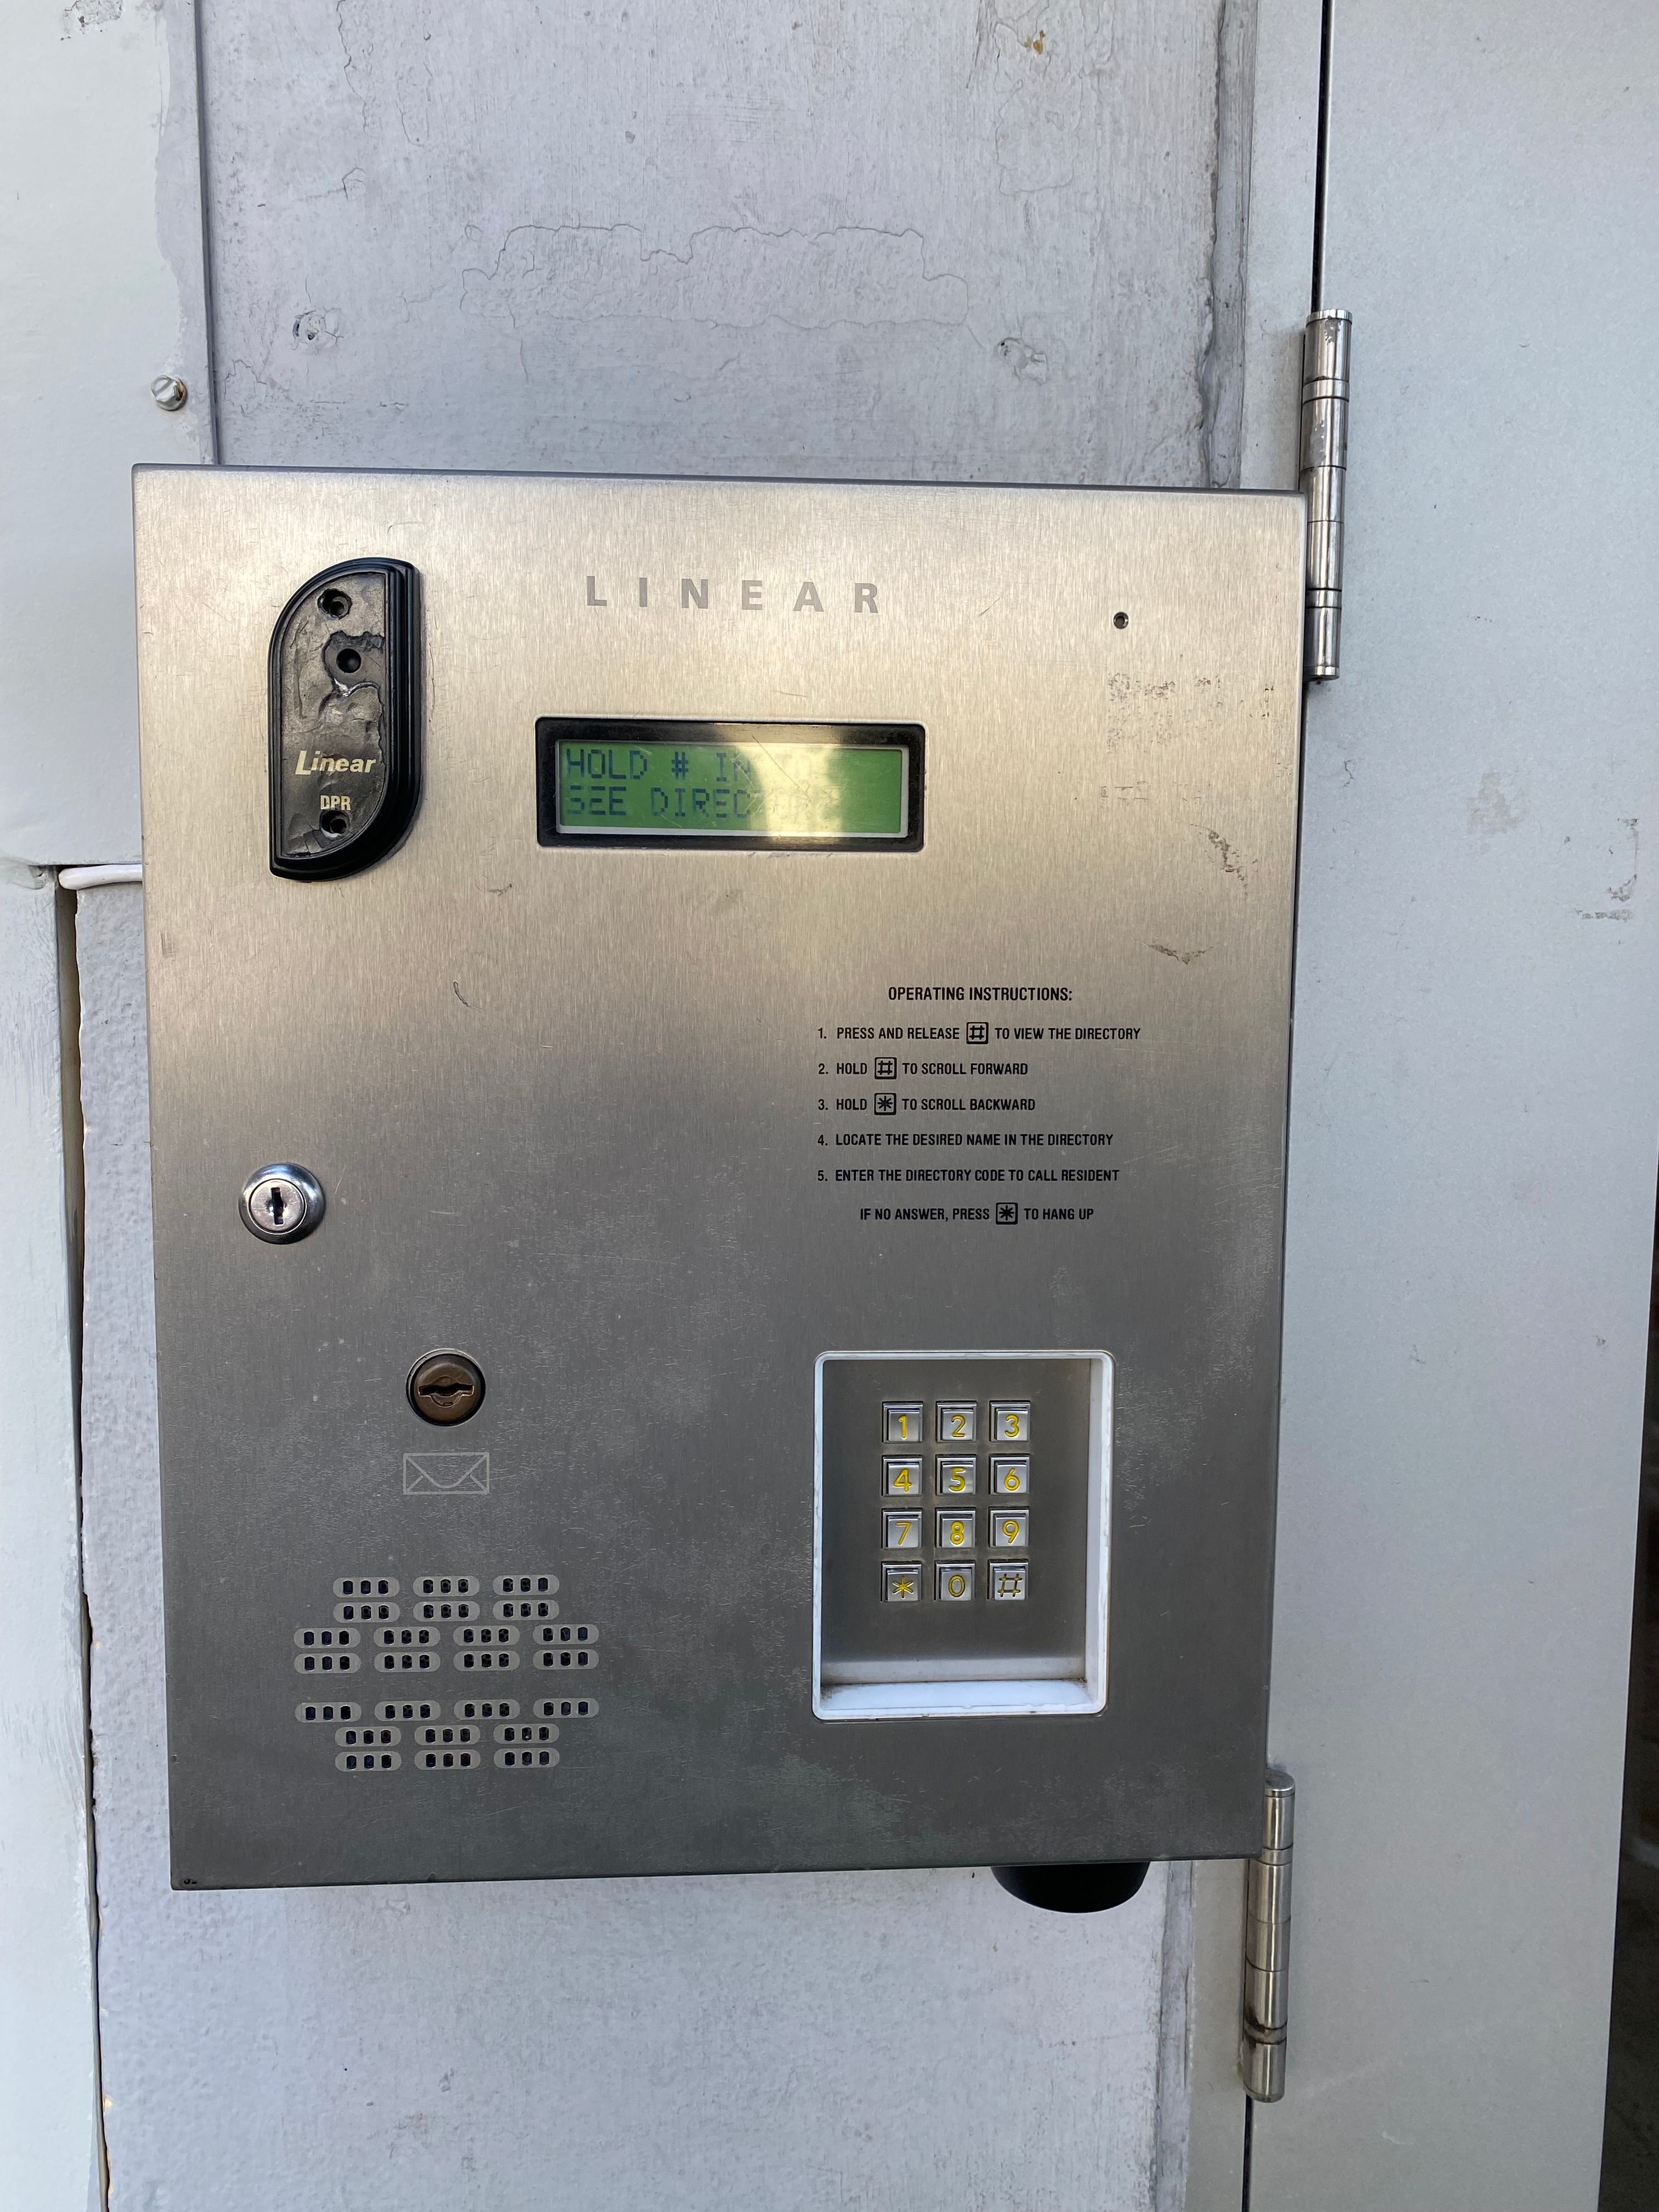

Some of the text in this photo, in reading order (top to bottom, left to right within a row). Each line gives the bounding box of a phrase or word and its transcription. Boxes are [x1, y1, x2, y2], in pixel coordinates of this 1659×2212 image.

[586, 575, 878, 613] LINEAR
[295, 750, 376, 775] Linear
[567, 748, 647, 780] HOLD
[320, 794, 351, 811] DPR
[567, 785, 627, 816] SEE
[888, 986, 1073, 1001] OPERATING INSTRUCTIONS:
[817, 1027, 827, 1039] 1.
[837, 1027, 874, 1040] PRESS
[878, 1027, 903, 1040] AND
[907, 1027, 960, 1040] RELEASE
[994, 1027, 1010, 1040] TO
[1013, 1028, 1044, 1040] VIEW
[1047, 1028, 1071, 1040] THE
[1075, 1028, 1141, 1040] DIRECTORY
[818, 1063, 829, 1075] 2.
[836, 1062, 867, 1075] HOLD
[901, 1062, 918, 1075] TO
[921, 1063, 967, 1075] SCROLL
[970, 1063, 1028, 1075] FORWARD
[818, 1098, 828, 1111] 3.
[836, 1098, 867, 1111] HOLD
[901, 1098, 917, 1110] TO
[921, 1098, 966, 1110] SCROLL
[969, 1098, 1035, 1111] BACKWARD
[817, 1133, 1114, 1146] 4. LOCATE THE DESIRED NAME IN THE DIRECTORY
[817, 1169, 1120, 1182] 5. ENTER THE DIRECTORY CODE TO CALL RESIDENT
[860, 1208, 872, 1221] IF
[874, 1208, 891, 1220] NO
[894, 1208, 949, 1222] ANSWER,
[952, 1207, 990, 1220] PRESS
[1023, 1207, 1039, 1220] TO
[1042, 1208, 1075, 1220] HANG
[1079, 1208, 1094, 1220] UP
[898, 1414, 907, 1438] 1
[951, 1414, 966, 1437] 2
[1005, 1414, 1019, 1438] 3
[893, 1468, 912, 1492] 4
[949, 1467, 966, 1492] 5
[1004, 1468, 1020, 1491] 6
[895, 1521, 911, 1545] 7
[950, 1520, 964, 1545] 8
[1002, 1520, 1019, 1544] 9
[948, 1575, 966, 1598] 0
